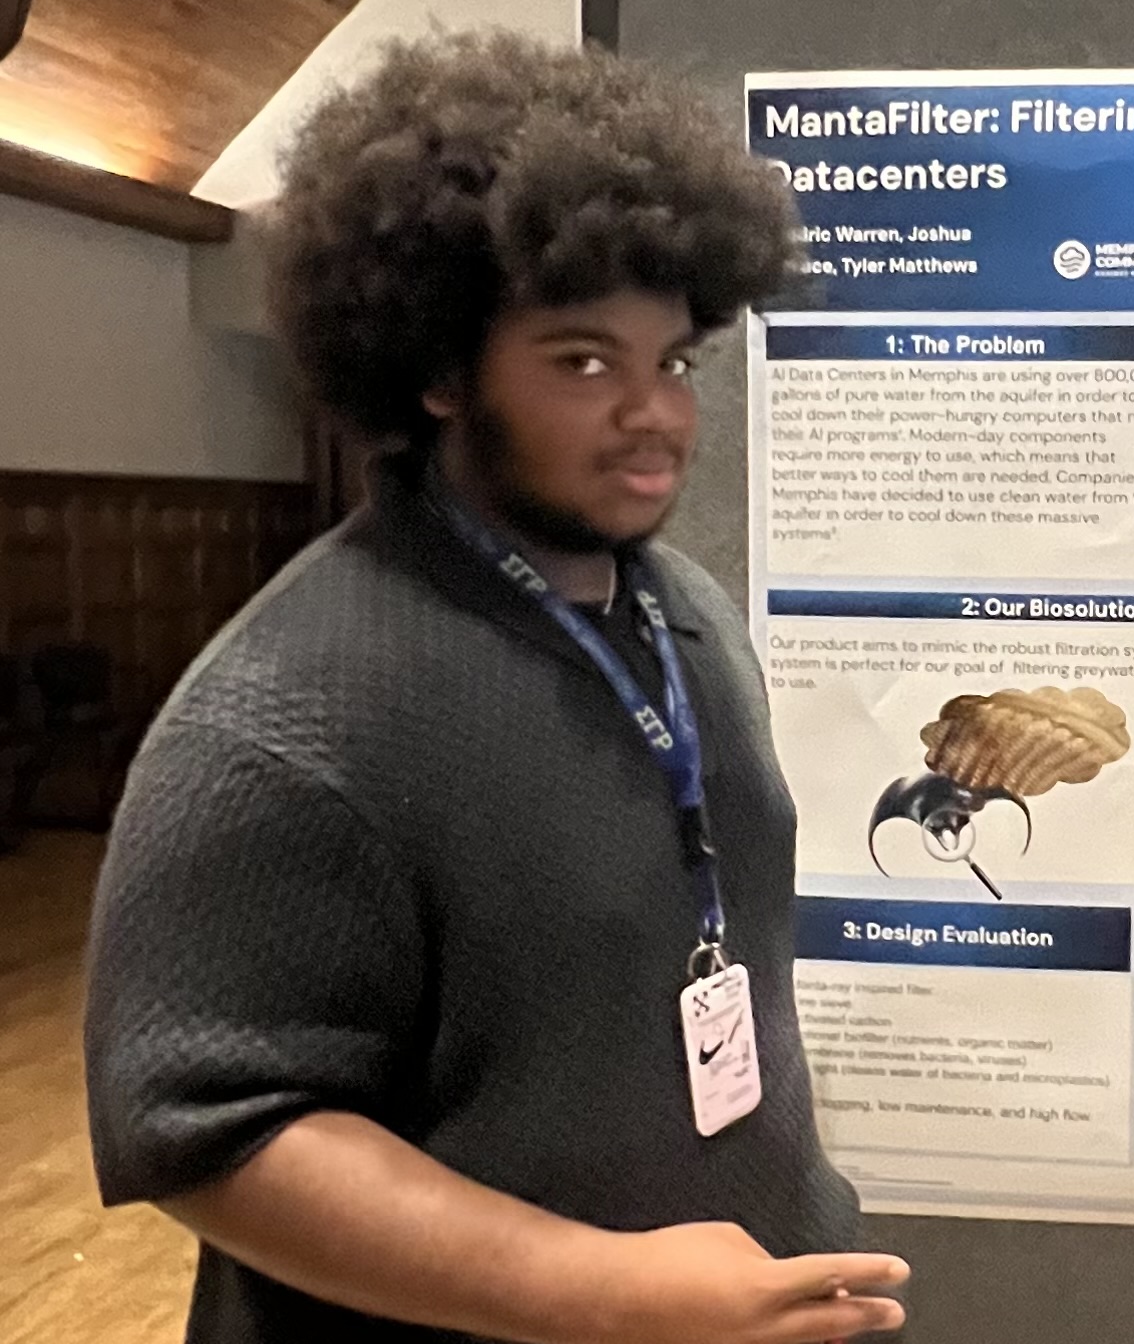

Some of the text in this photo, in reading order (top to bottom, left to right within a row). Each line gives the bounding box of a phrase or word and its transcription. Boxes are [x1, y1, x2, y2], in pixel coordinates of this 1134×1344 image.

[764, 100, 1000, 138] MantaFilter:
[835, 225, 904, 243] Warren,
[908, 226, 972, 242] Joshua
[841, 257, 886, 278] Tyler
[889, 258, 978, 274] Matthews
[886, 335, 1046, 354] 1: The Problem
[772, 368, 786, 381] AI
[789, 368, 823, 381] Data
[827, 368, 886, 382] Centers
[908, 368, 978, 385] Memphis
[983, 371, 1006, 383] are
[1011, 368, 1051, 386] using
[1056, 371, 1089, 383] over
[771, 388, 1117, 406] gallons pure water from the aquifer order
[771, 408, 802, 422] cool
[806, 408, 847, 422] down
[851, 408, 885, 422] their
[890, 409, 997, 425] power-hungry
[1002, 410, 1087, 426] computers
[1091, 409, 1122, 423] that
[772, 427, 804, 441] their
[808, 427, 824, 441] AI
[909, 428, 1004, 446] Modern-day
[1010, 431, 1107, 447] components
[772, 449, 823, 464] require
[827, 449, 866, 462] more
[870, 450, 921, 466] energy
[980, 449, 1026, 463] which
[1029, 451, 1080, 464] means
[1085, 450, 1116, 463] that
[772, 468, 817, 482] better
[820, 470, 858, 484] ways
[881, 469, 914, 483] cool
[918, 469, 958, 483] them
[962, 471, 986, 484] are
[772, 488, 838, 503] Memphis
[842, 488, 877, 502] have
[881, 488, 944, 503] decided
[968, 491, 995, 504] use
[1000, 490, 1041, 504] clean
[1045, 491, 1087, 505] water
[1092, 490, 1129, 505] from
[772, 507, 1100, 526] aquifer order cool down these massive
[962, 598, 981, 616] 2:
[984, 598, 1025, 617] Our
[770, 635, 797, 649] Our
[800, 636, 858, 653] product
[862, 638, 898, 652] aims
[922, 640, 968, 654] mimic
[973, 641, 998, 655] the
[1002, 641, 1051, 655] robust
[1055, 641, 1119, 657] filtration
[770, 656, 822, 672] system
[841, 658, 895, 675] perfect
[899, 659, 921, 672] for
[925, 661, 950, 673] our
[954, 660, 985, 677] goal
[1012, 661, 1069, 679] filtering
[771, 675, 785, 688] to
[843, 921, 1054, 947] 3: Design Evaluation
